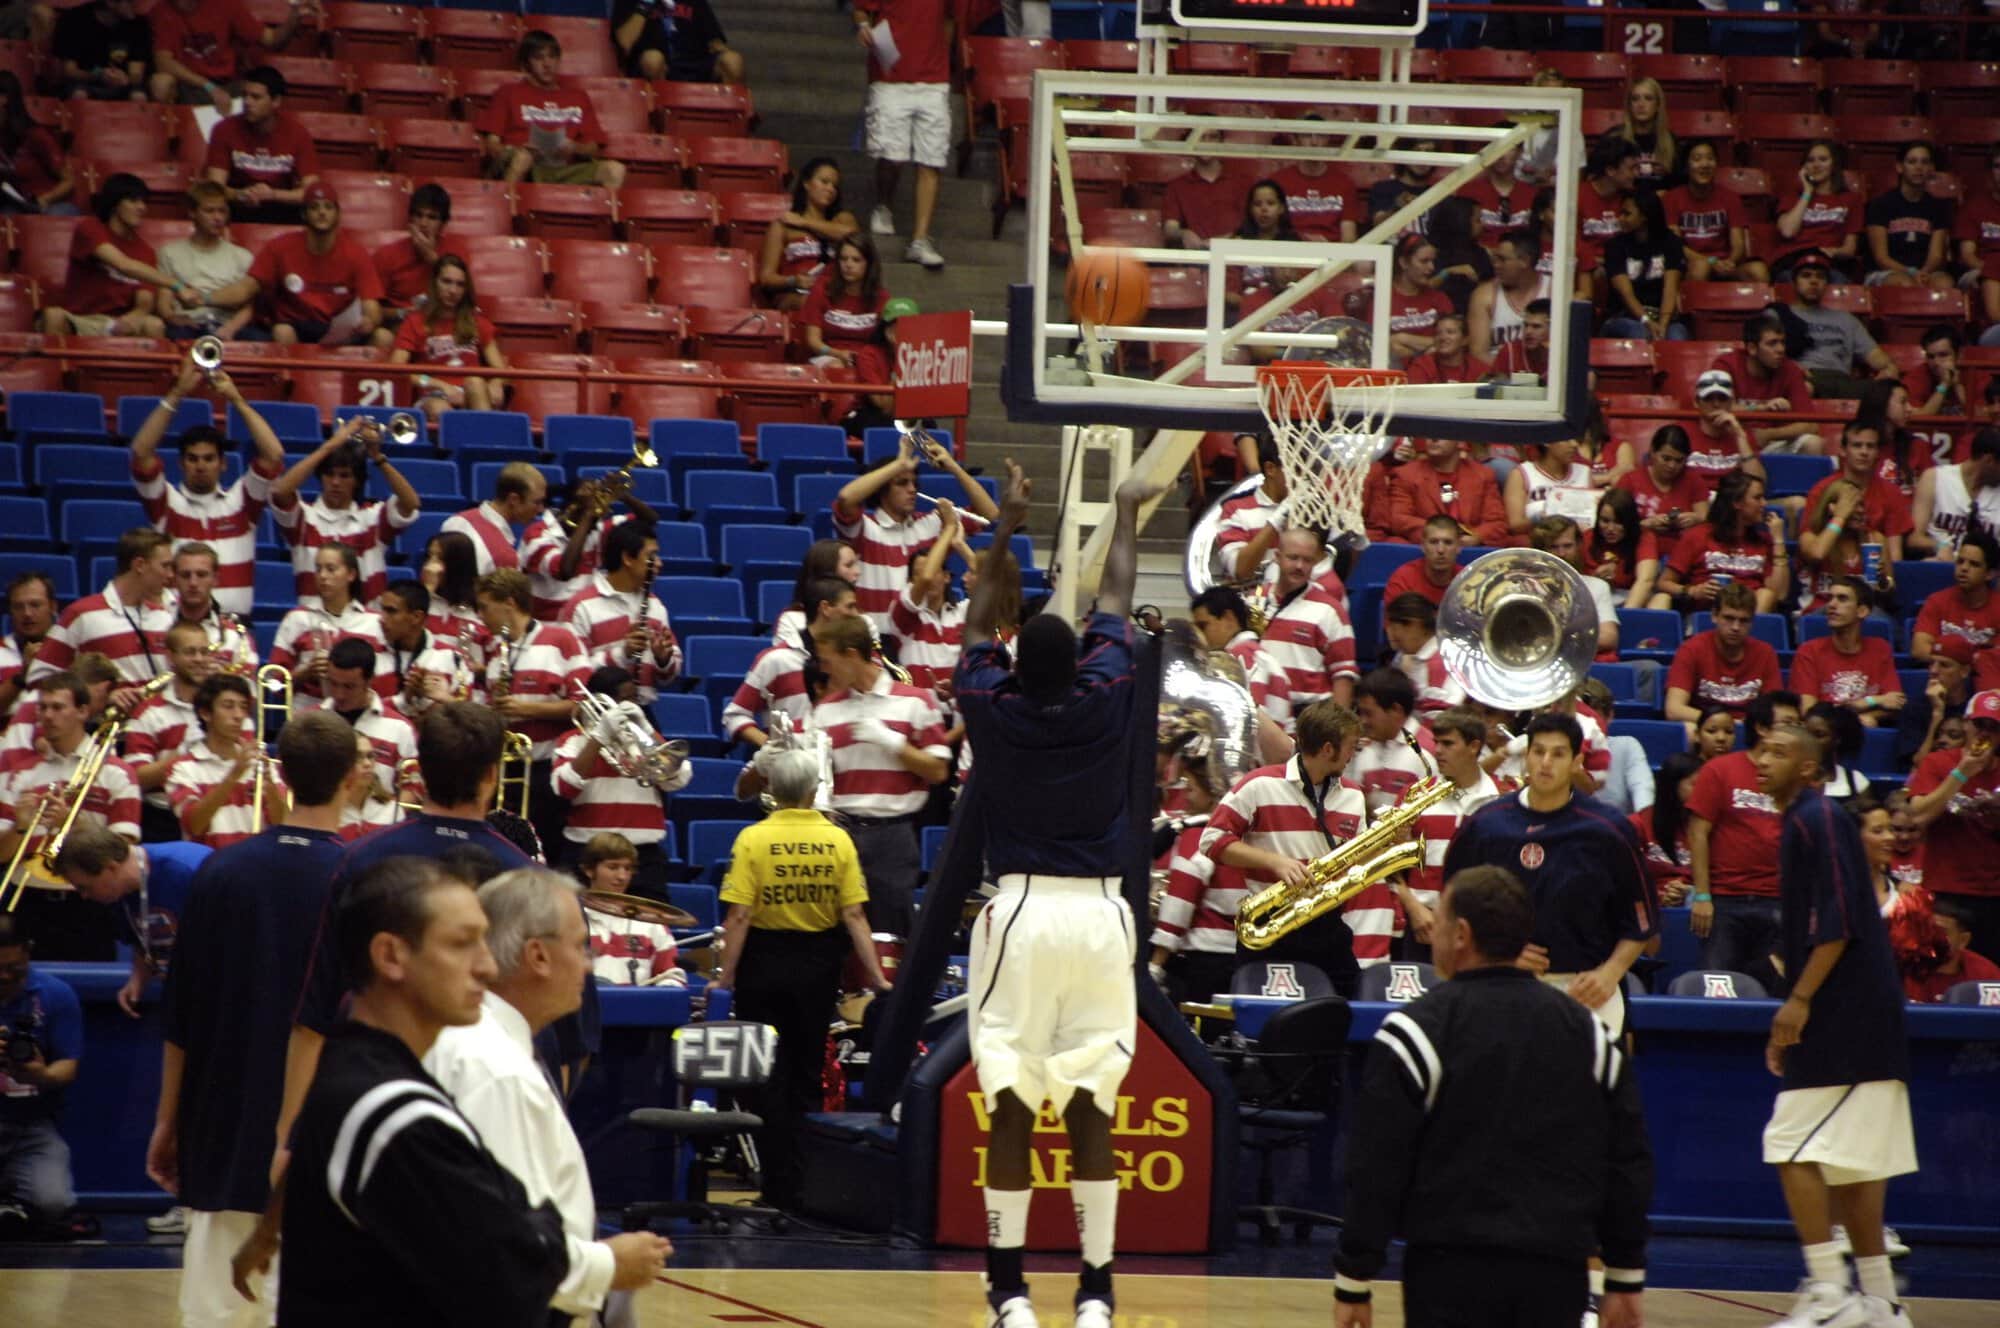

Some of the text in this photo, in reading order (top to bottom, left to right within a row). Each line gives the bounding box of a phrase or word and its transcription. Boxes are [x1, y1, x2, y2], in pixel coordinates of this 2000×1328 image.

[1624, 23, 1664, 54] 22
[358, 379, 394, 408] 21
[769, 842, 836, 856] EVENT
[775, 864, 836, 878] STAFF
[762, 883, 840, 905] SECURITY
[675, 1025, 778, 1078] FSN
